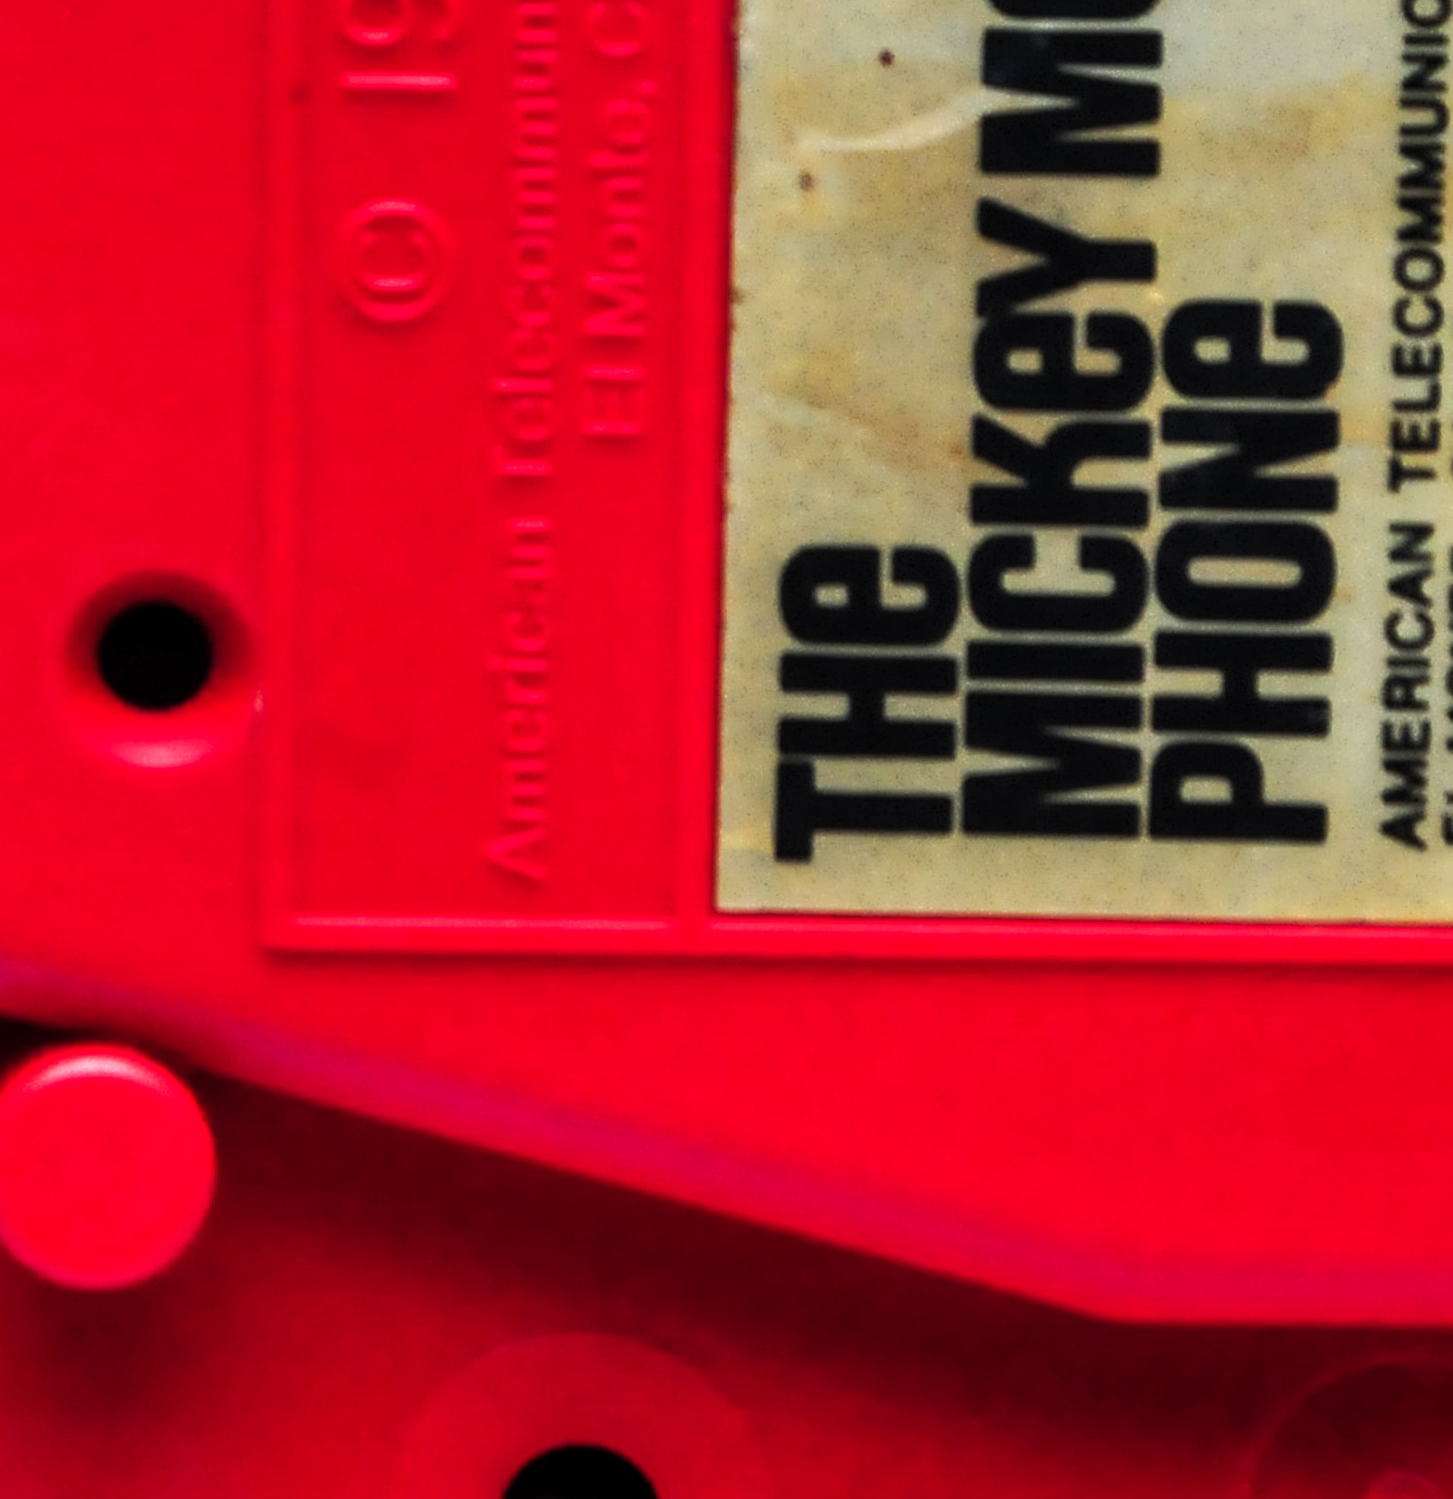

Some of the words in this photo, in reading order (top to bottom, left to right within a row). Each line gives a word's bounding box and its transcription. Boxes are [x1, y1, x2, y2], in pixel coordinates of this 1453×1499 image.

[583, 78, 657, 340] Monte,
[583, 363, 646, 437] El
[481, 518, 551, 884] American
[1379, 521, 1436, 852] AMERICAN
